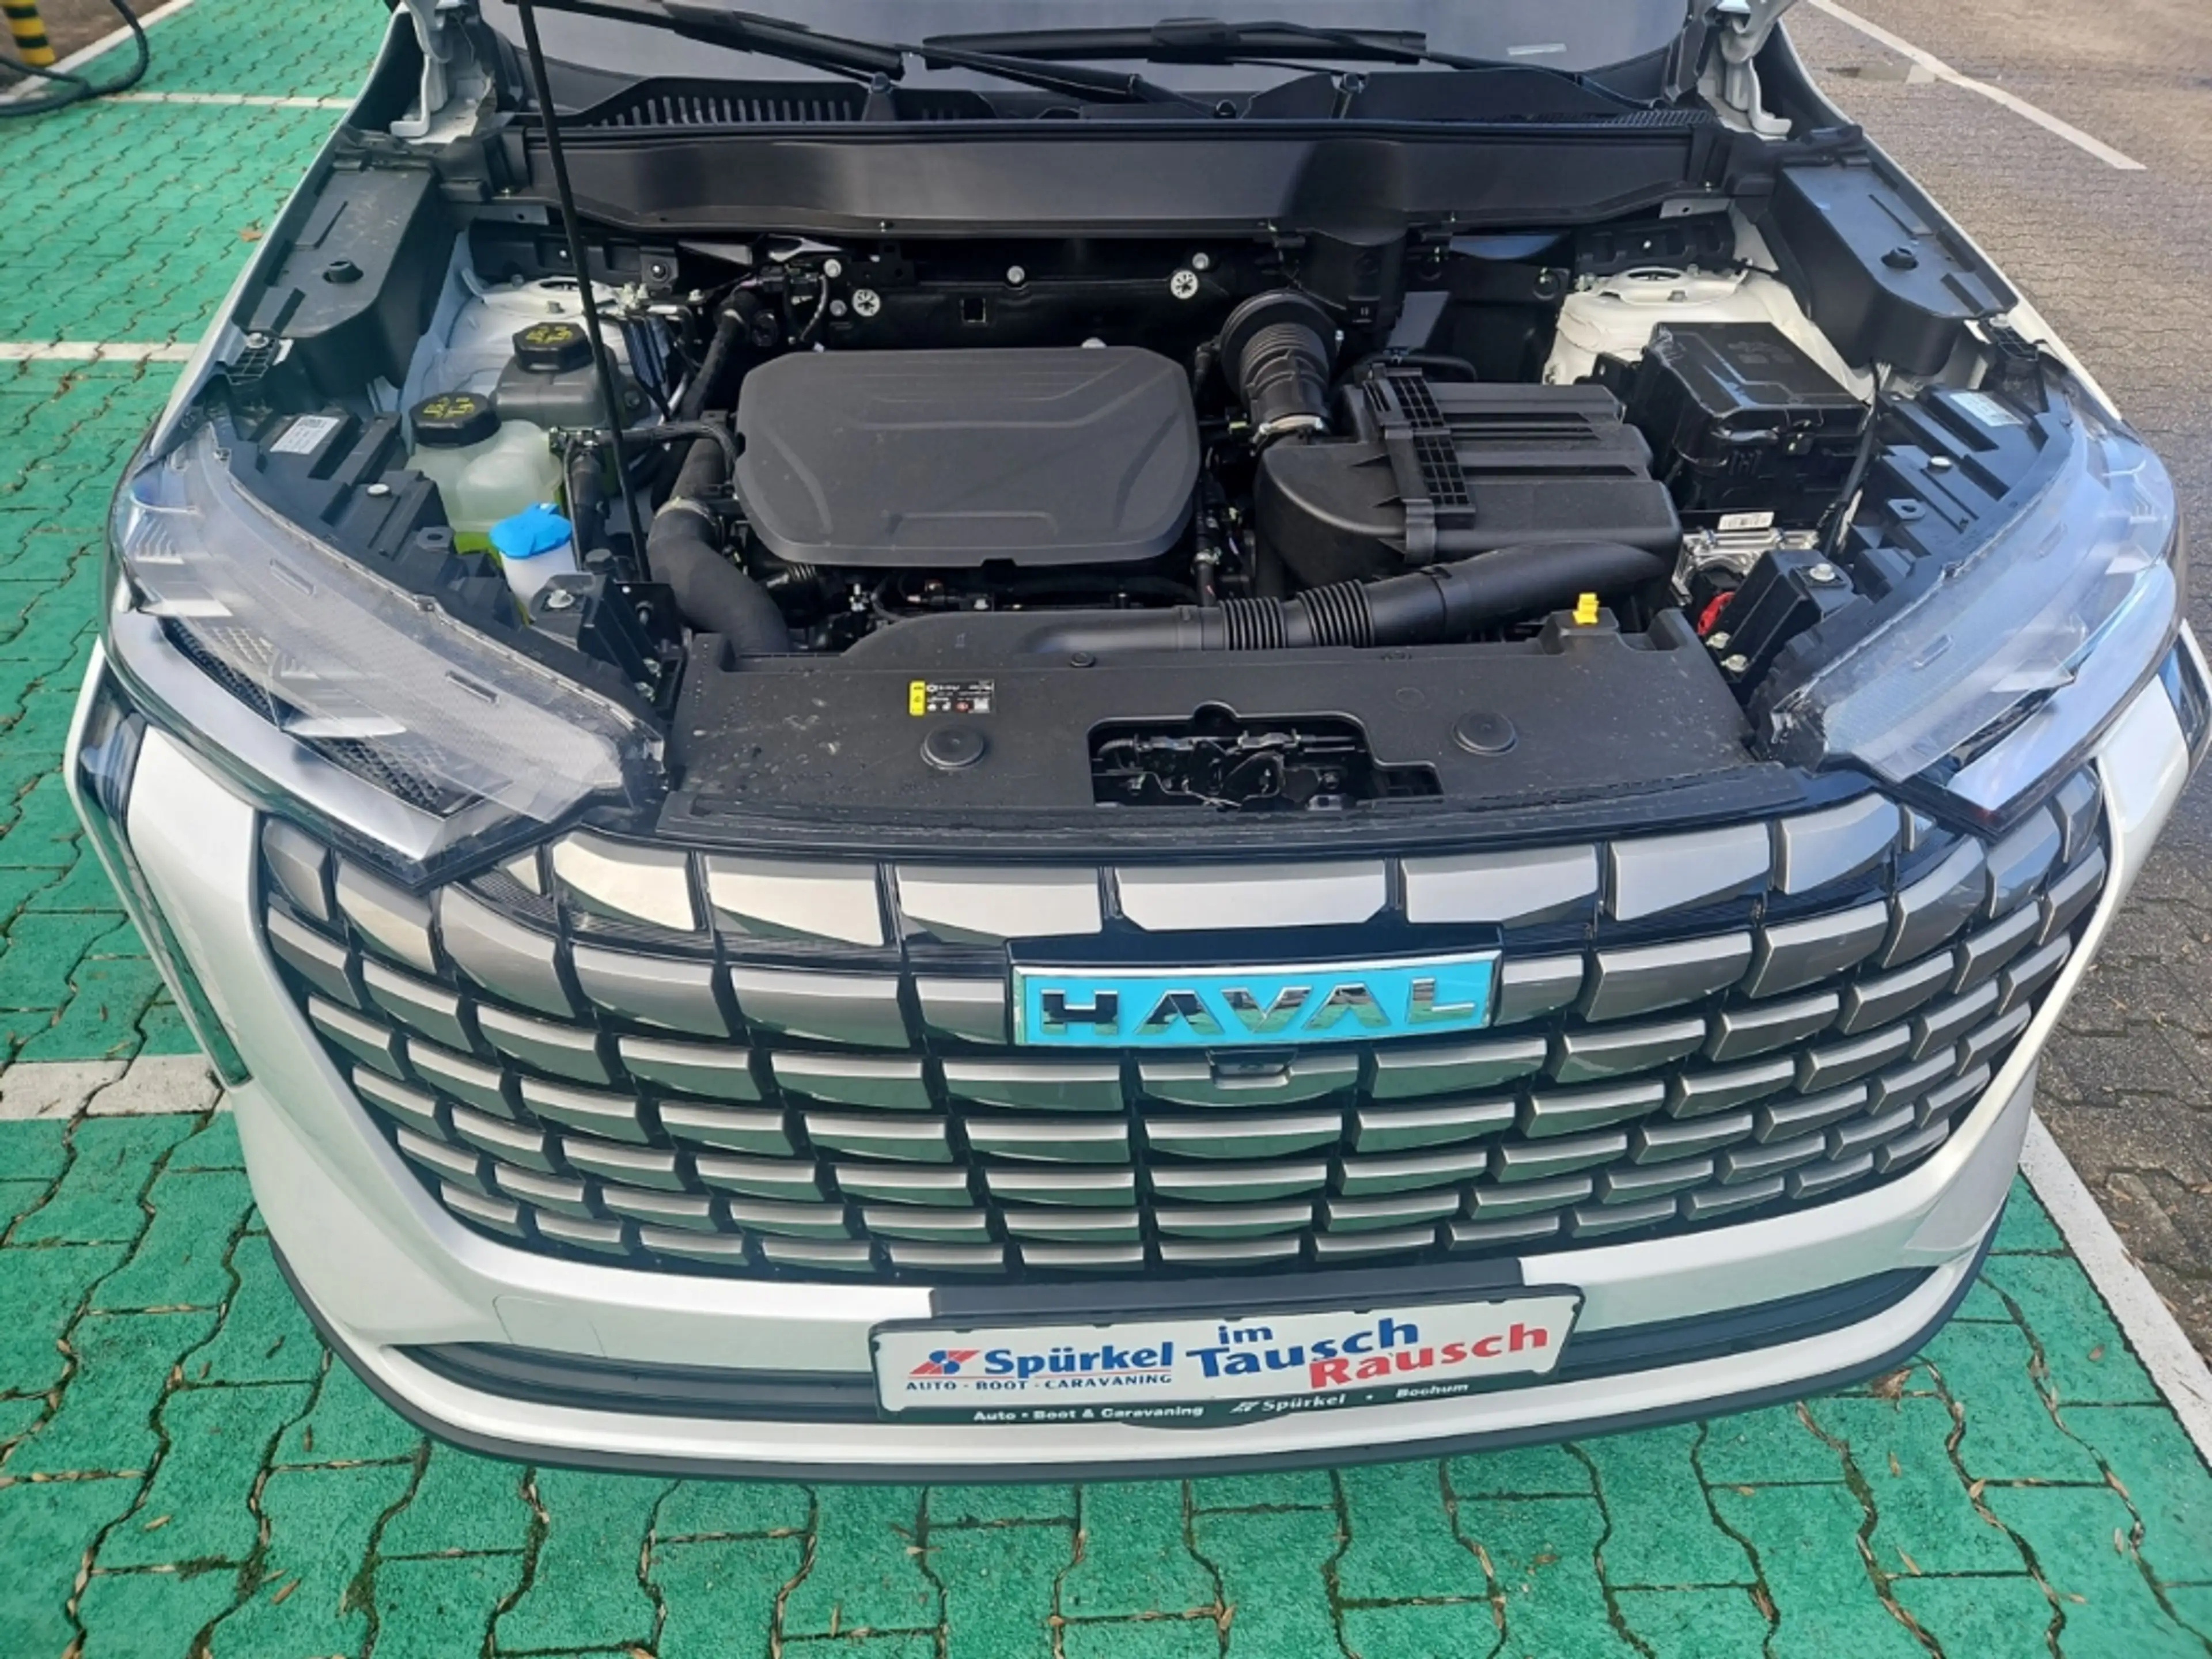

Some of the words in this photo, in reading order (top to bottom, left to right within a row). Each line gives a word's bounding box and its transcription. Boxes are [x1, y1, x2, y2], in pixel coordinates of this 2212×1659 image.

[1041, 978, 1475, 1035] HAVAL
[1185, 1318, 1420, 1378] Tausch
[1218, 1325, 1274, 1345] im
[984, 1341, 1173, 1378] Spürkel
[1309, 1323, 1548, 1389] Rausch
[906, 1380, 957, 1391] AUTO
[975, 1380, 1028, 1390] BOOT
[1045, 1374, 1172, 1389] CARAVANING
[974, 1410, 1016, 1421] Auto
[1033, 1409, 1076, 1420] Boot
[1082, 1408, 1094, 1419] &
[1101, 1406, 1204, 1418] Caravaning
[1261, 1393, 1347, 1412] Spürkel
